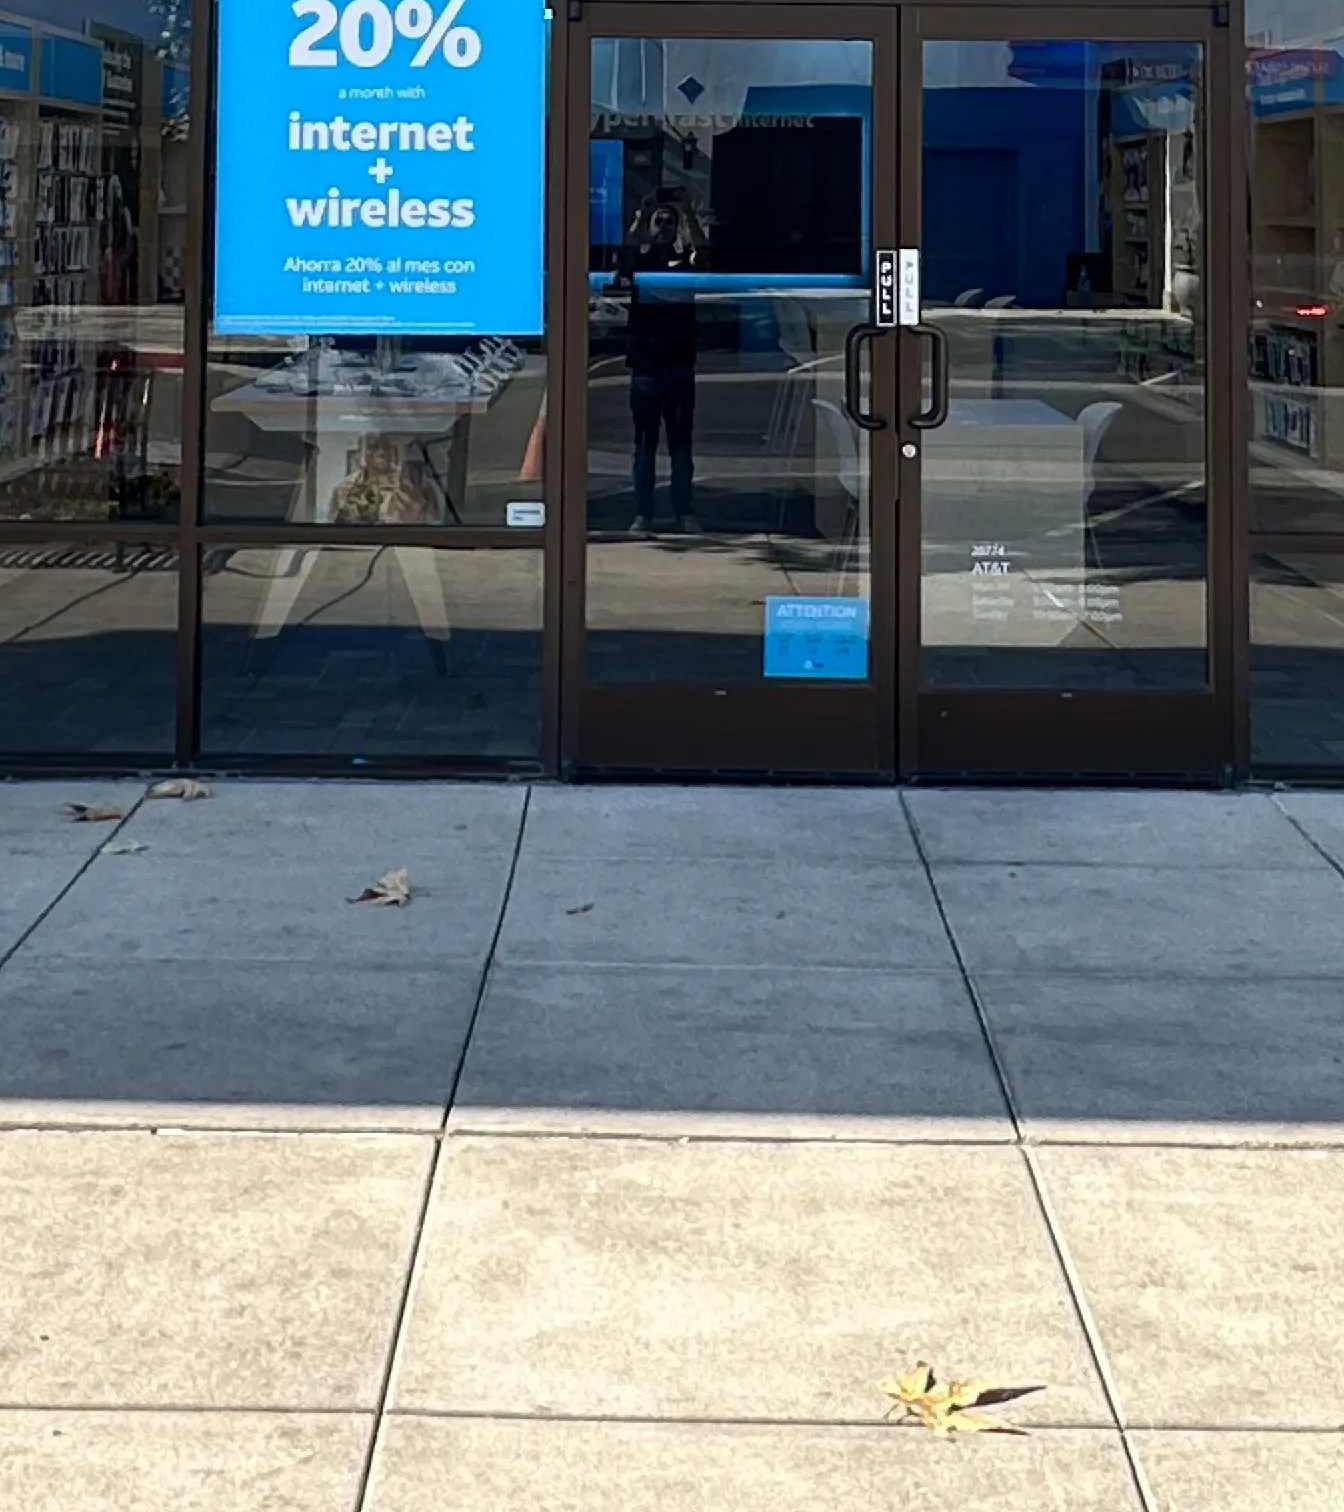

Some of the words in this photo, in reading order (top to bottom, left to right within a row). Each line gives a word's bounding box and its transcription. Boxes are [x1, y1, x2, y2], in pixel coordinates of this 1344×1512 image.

[338, 88, 347, 99] a
[349, 86, 393, 99] month
[397, 85, 426, 99] with
[288, 110, 474, 151] internet
[368, 157, 394, 184] +
[285, 187, 476, 228] wireless
[283, 256, 342, 273] Ahorra
[345, 256, 383, 273] 20%
[386, 256, 401, 273] al
[405, 260, 441, 273] mes
[444, 260, 476, 273] con
[389, 276, 457, 294] wireless
[880, 261, 893, 315] PULL
[972, 561, 1011, 576] AT&T
[777, 604, 856, 618] ATTENTION
